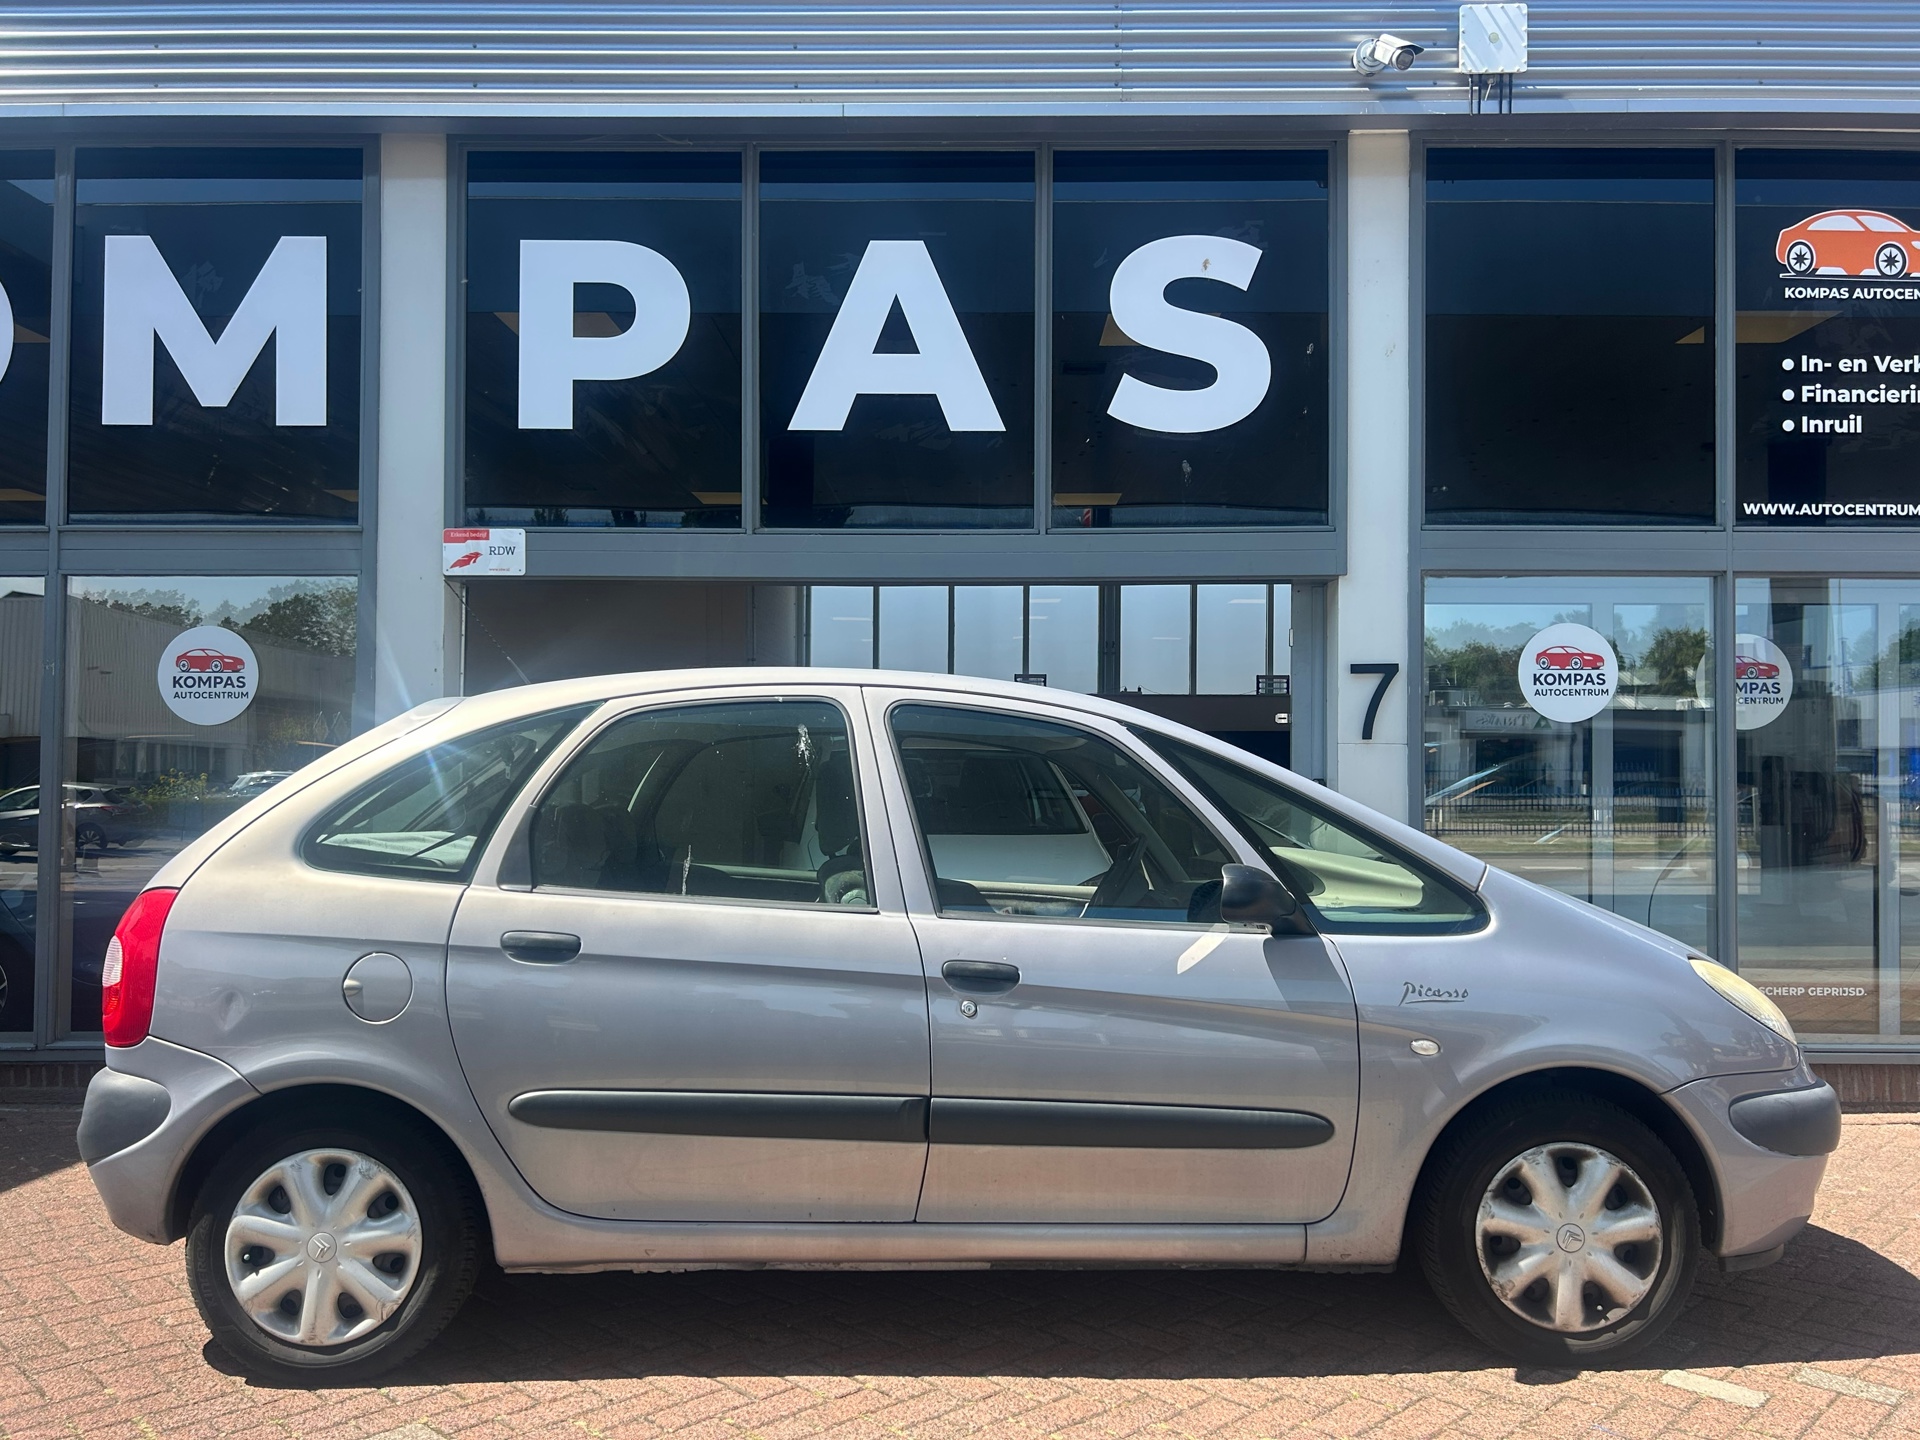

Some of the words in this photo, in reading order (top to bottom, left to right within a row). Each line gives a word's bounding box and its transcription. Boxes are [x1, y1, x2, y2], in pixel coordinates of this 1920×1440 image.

[1784, 287, 1850, 299] KOMPAS
[0, 234, 1273, 434] MPAS
[1801, 355, 1832, 372] In-
[1838, 358, 1868, 372] en
[1801, 383, 1920, 403] Financieri
[1801, 414, 1862, 433] Inruil
[1743, 503, 1920, 516] WWW.AUTOCENTRUM
[488, 546, 516, 556] RDW
[172, 676, 246, 689] KOMPAS
[1533, 673, 1606, 686] KOMPAS
[173, 691, 249, 699] AUTOCENTRUM
[1534, 688, 1609, 697] AUTOCENTRUM
[1350, 663, 1400, 740] 7
[1736, 697, 1784, 705] CENTRUM
[1398, 981, 1469, 1006] Picasso
[1808, 987, 1868, 997] GEPRIJSD.
